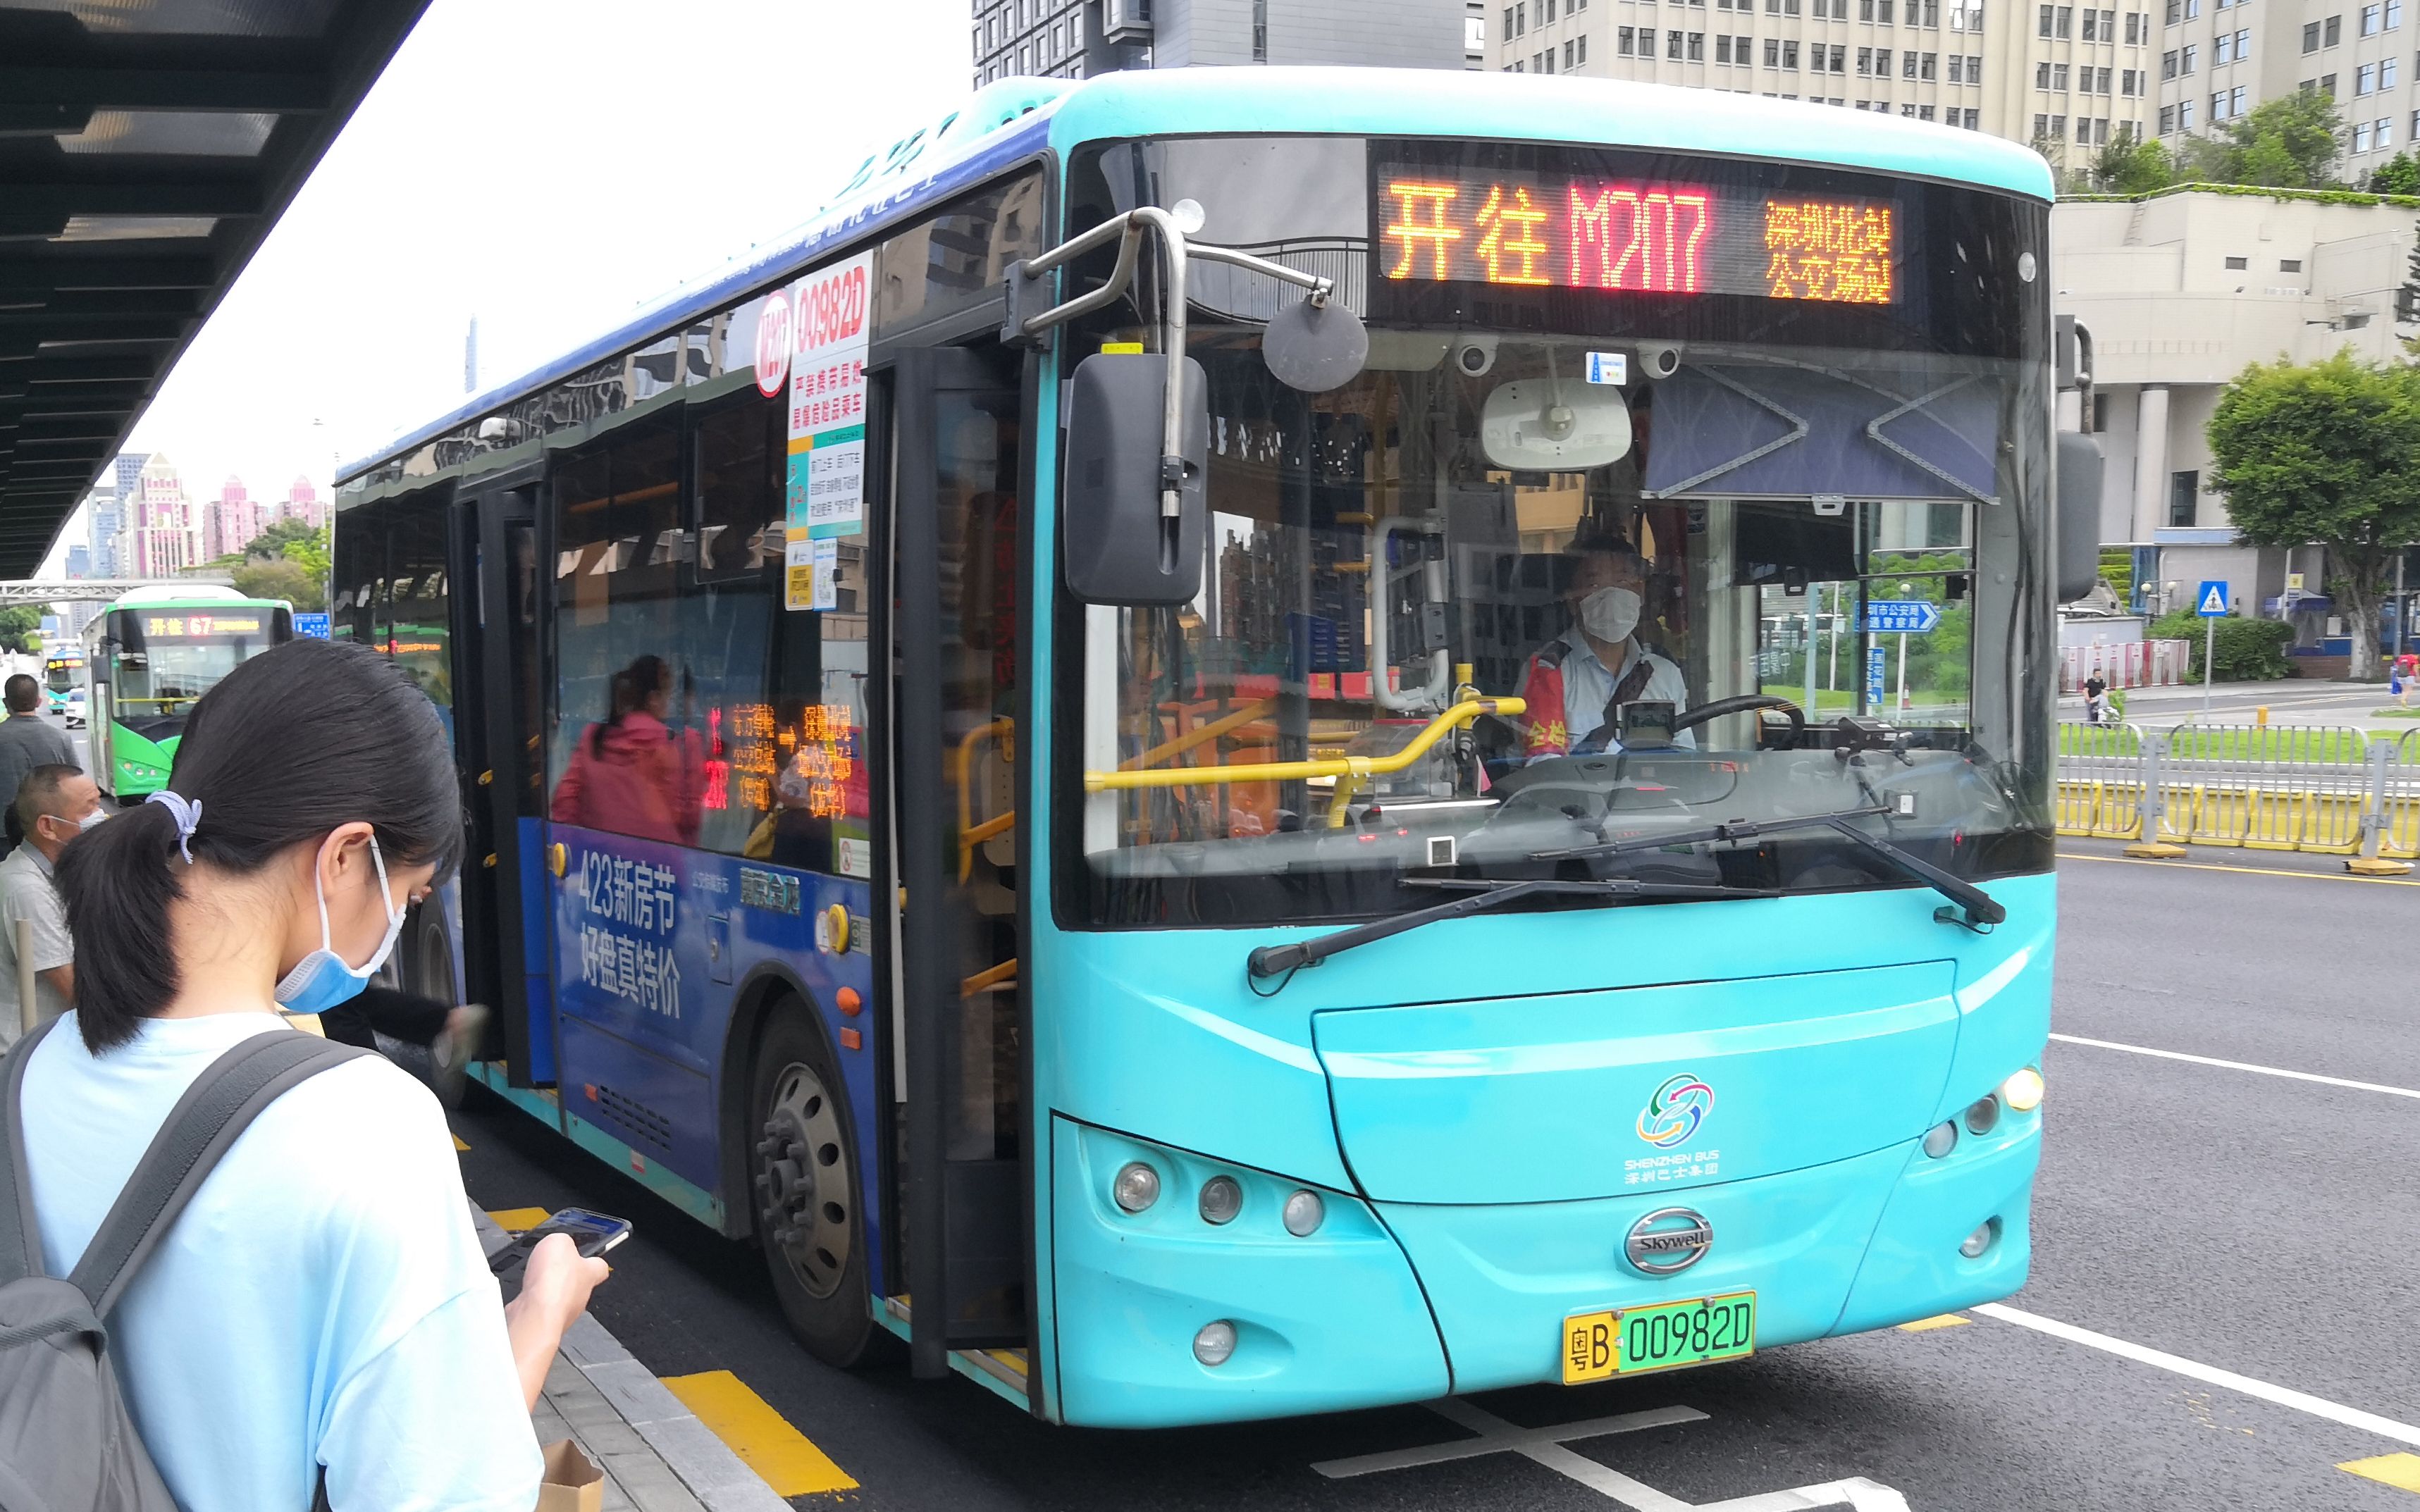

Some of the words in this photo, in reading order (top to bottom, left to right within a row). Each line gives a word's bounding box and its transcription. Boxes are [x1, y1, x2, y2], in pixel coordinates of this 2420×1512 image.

[1386, 184, 1551, 286] 开往
[1569, 185, 1708, 293] M207
[1764, 200, 1892, 256] 深圳北站
[798, 266, 865, 353] 00982D
[150, 617, 183, 636] 开往
[190, 615, 212, 636] 67
[1860, 604, 1919, 616] 圳市公安局
[1860, 616, 1919, 629] 通警察局
[579, 849, 676, 936] 423新房节
[580, 922, 681, 1020] 好盘真特价
[1624, 1153, 1691, 1171] SHENZHEN
[1694, 1149, 1720, 1163] BUS
[1624, 1163, 1719, 1185] 深圳巴士集团
[1640, 1232, 1705, 1252] Skywell
[1571, 1323, 1610, 1372] 粤B
[1629, 1302, 1751, 1363] 00982D
